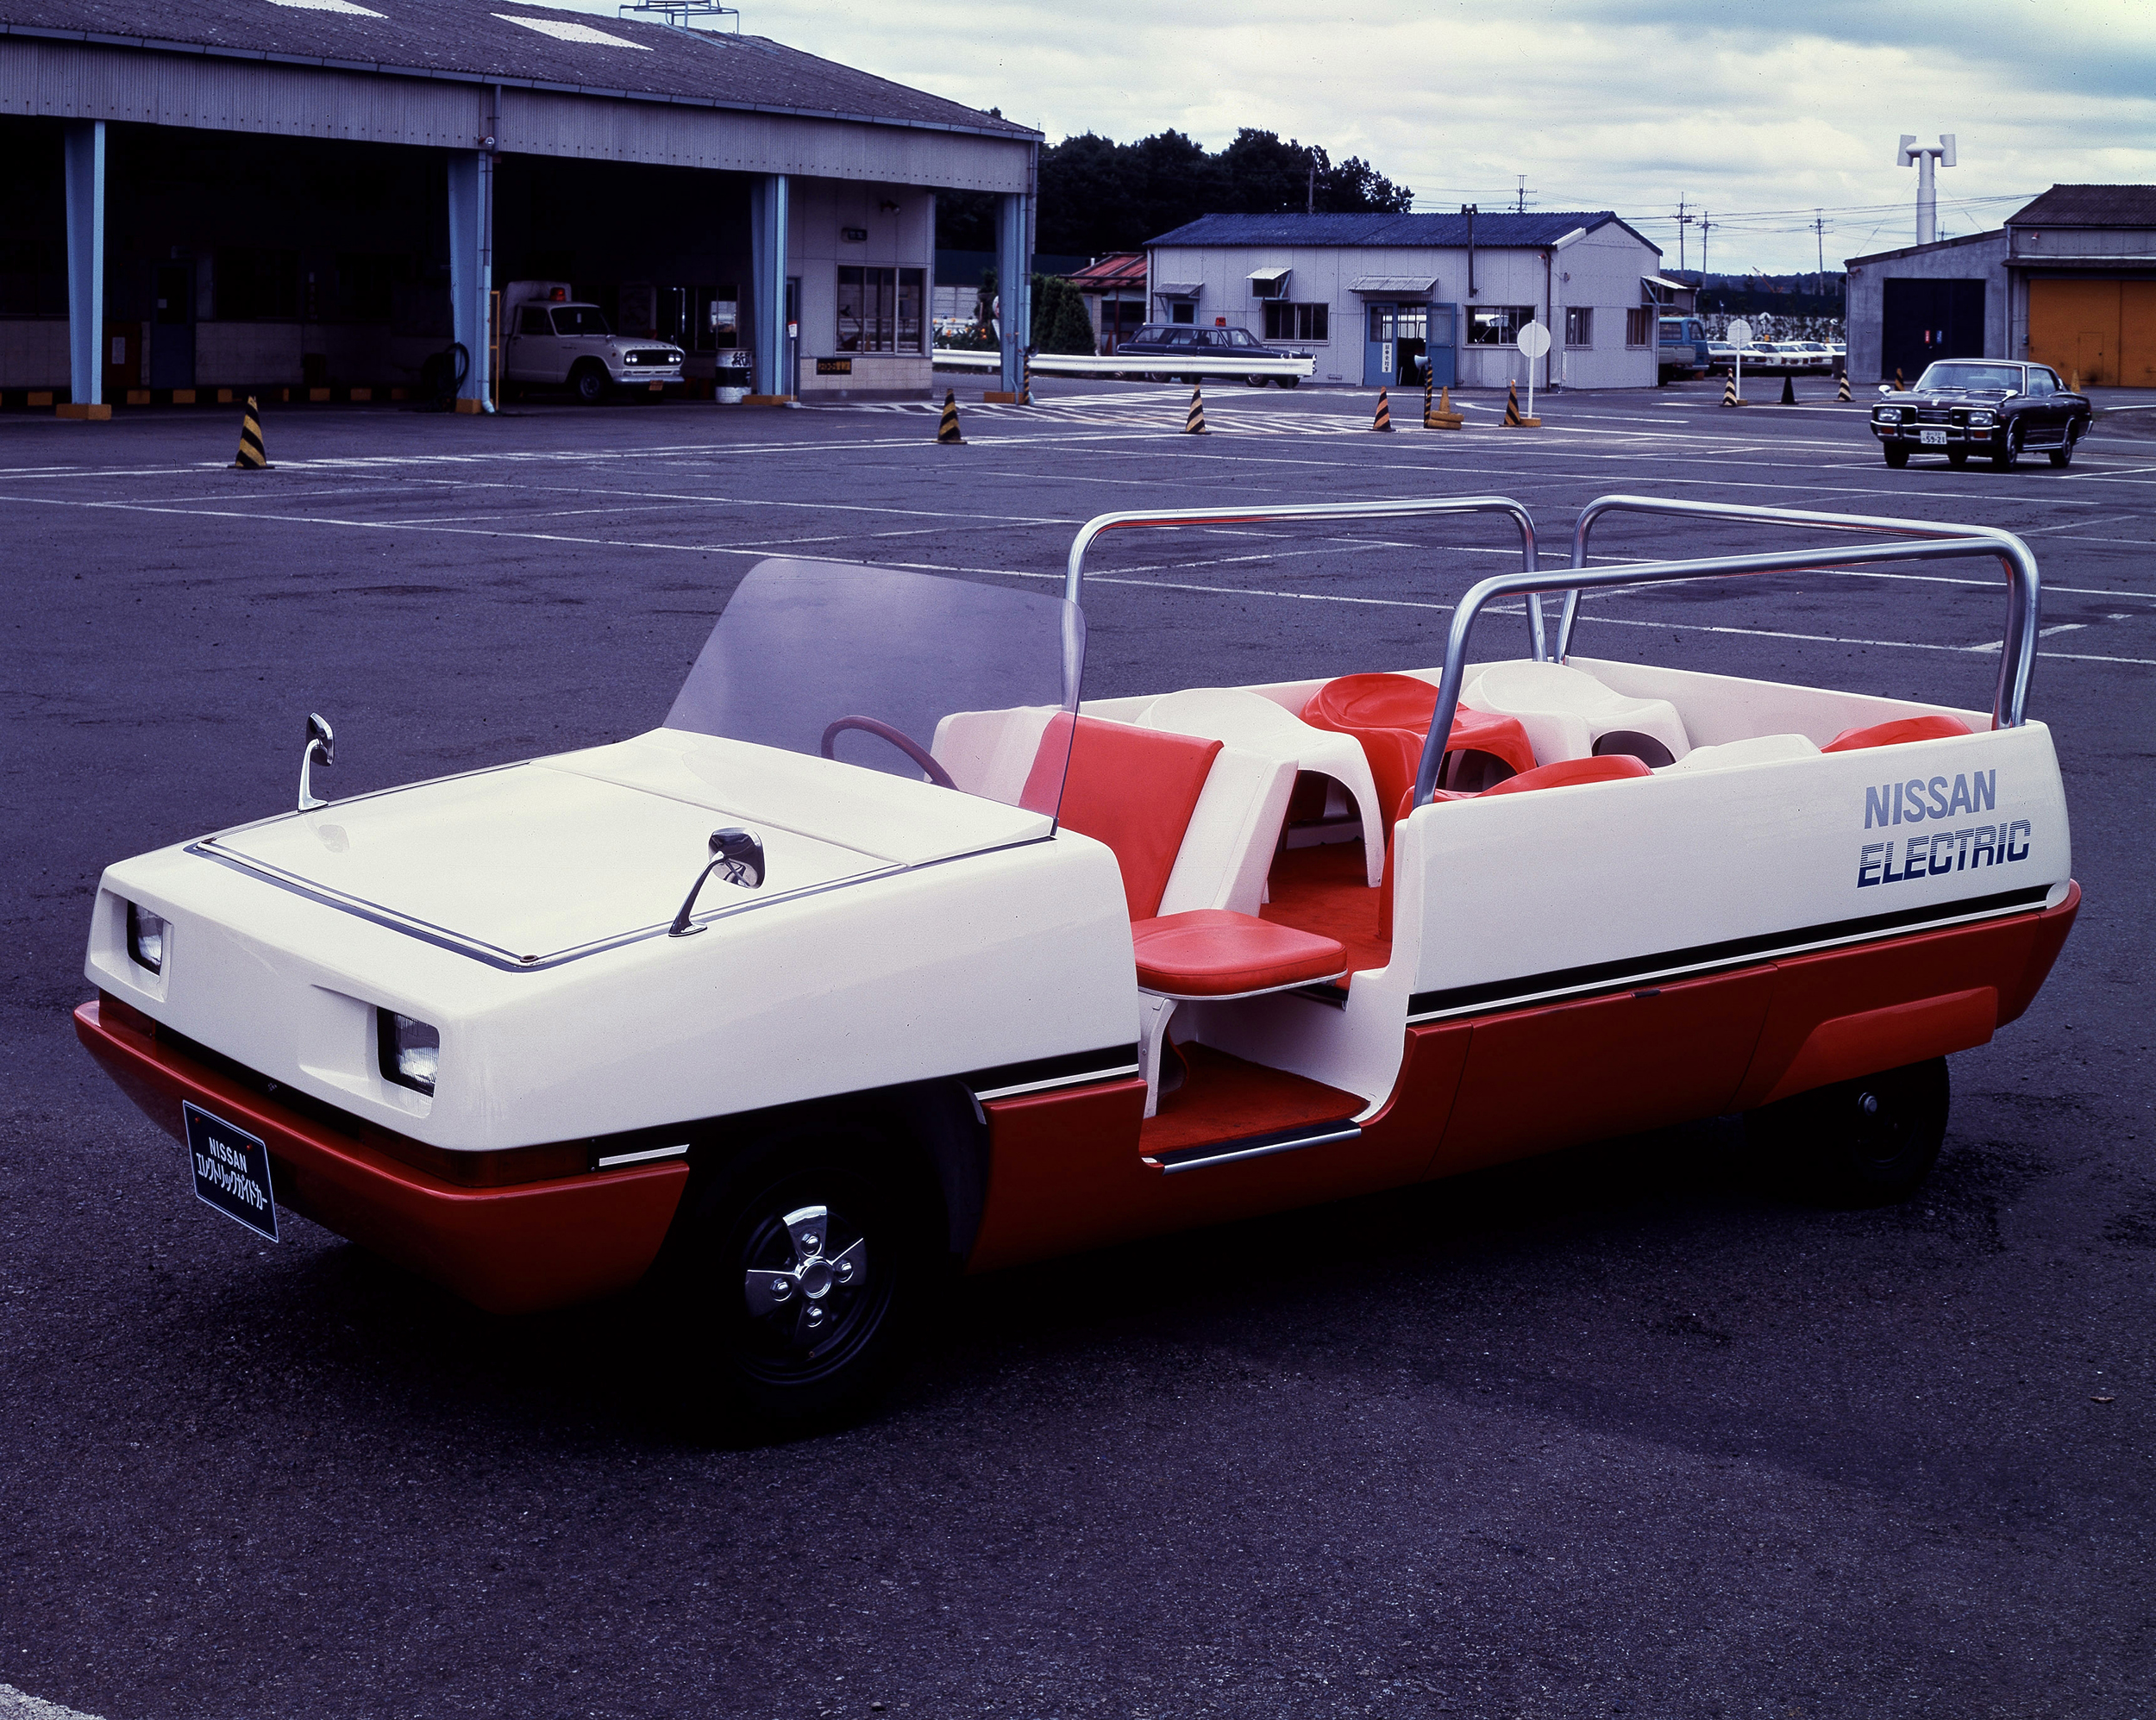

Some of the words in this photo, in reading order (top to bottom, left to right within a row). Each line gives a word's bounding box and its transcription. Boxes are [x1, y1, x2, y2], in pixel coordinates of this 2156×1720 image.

[1864, 768, 1996, 829] NISSAN
[1857, 818, 2032, 889] ELECTRIC
[196, 1152, 268, 1210] エレクトリックガイドカー
[208, 1136, 248, 1173] NISSAN
